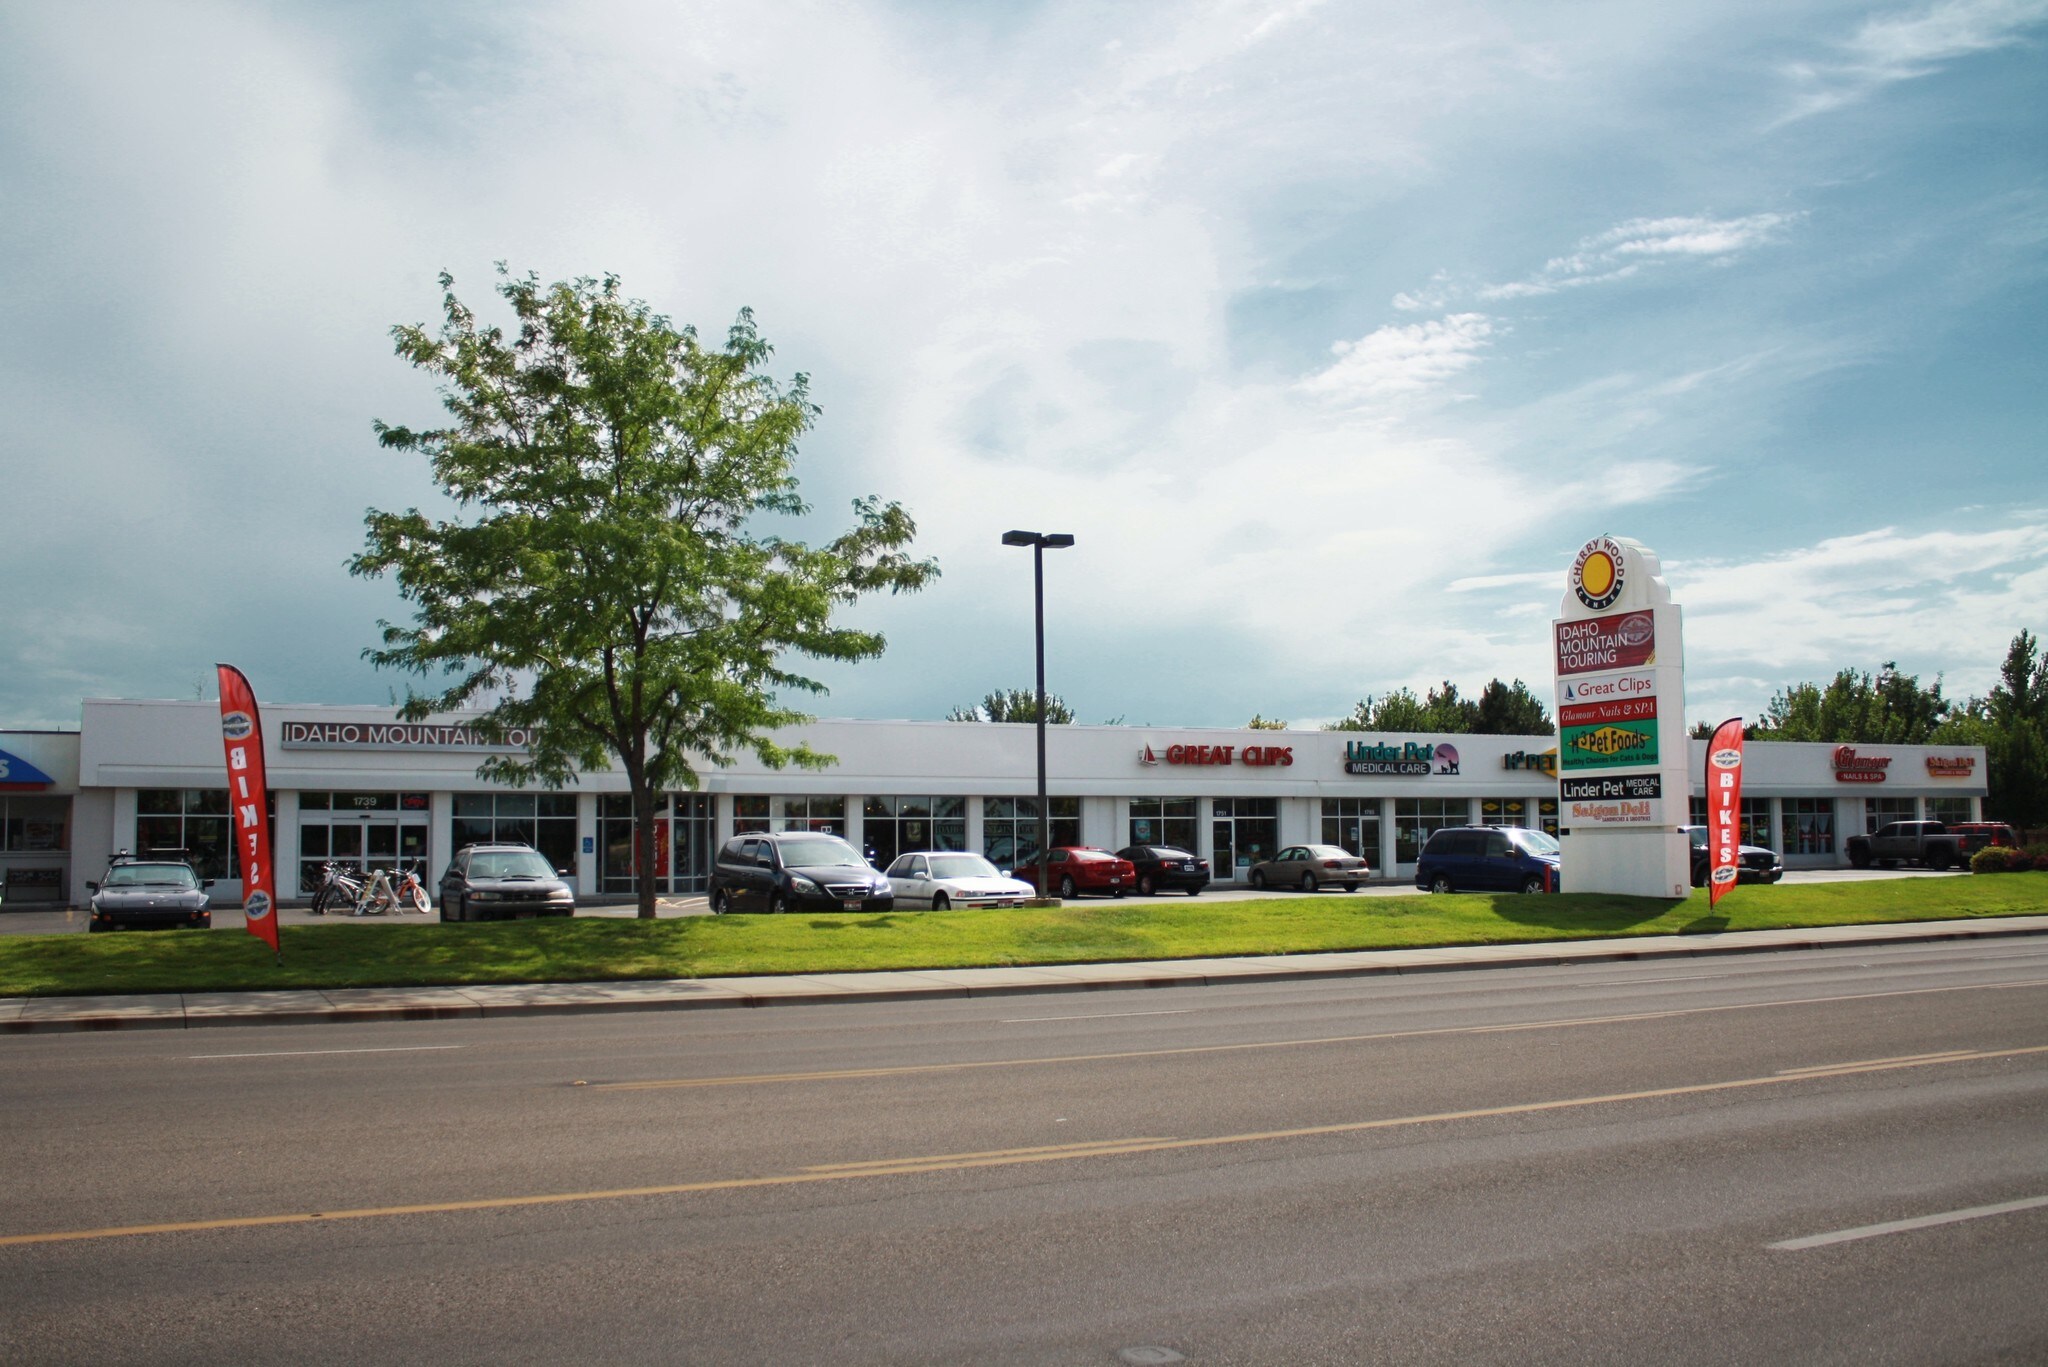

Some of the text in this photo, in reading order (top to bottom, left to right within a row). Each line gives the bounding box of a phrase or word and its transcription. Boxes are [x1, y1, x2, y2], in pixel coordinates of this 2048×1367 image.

[1573, 539, 1625, 585] CHERRY WOOD
[1577, 583, 1623, 608] CENTER
[1559, 622, 1599, 641] IDAHO
[1560, 633, 1628, 655] MOUNTAIN
[1561, 649, 1617, 669] TOURING
[1578, 678, 1651, 697] Great Clips
[1561, 702, 1654, 722] Glamour Nails & SPA
[285, 724, 541, 747] IDAHO MOUNTAIN TOU
[1589, 730, 1608, 753] Pet
[1611, 729, 1646, 751] Foods
[1166, 744, 1294, 767] GREAT CLIPS
[1347, 741, 1434, 760] Linder Pet
[1610, 754, 1619, 762] for
[1834, 745, 1892, 769] Glamour
[1352, 763, 1427, 773] MEDICAL CARE
[1564, 781, 1624, 798] Linder Pet
[1626, 779, 1659, 787] MEDICAL
[1633, 787, 1654, 796] CARE
[353, 797, 377, 806] 1739
[1572, 802, 1651, 820] Saigon Deli
[1719, 773, 1734, 863] BIKES
